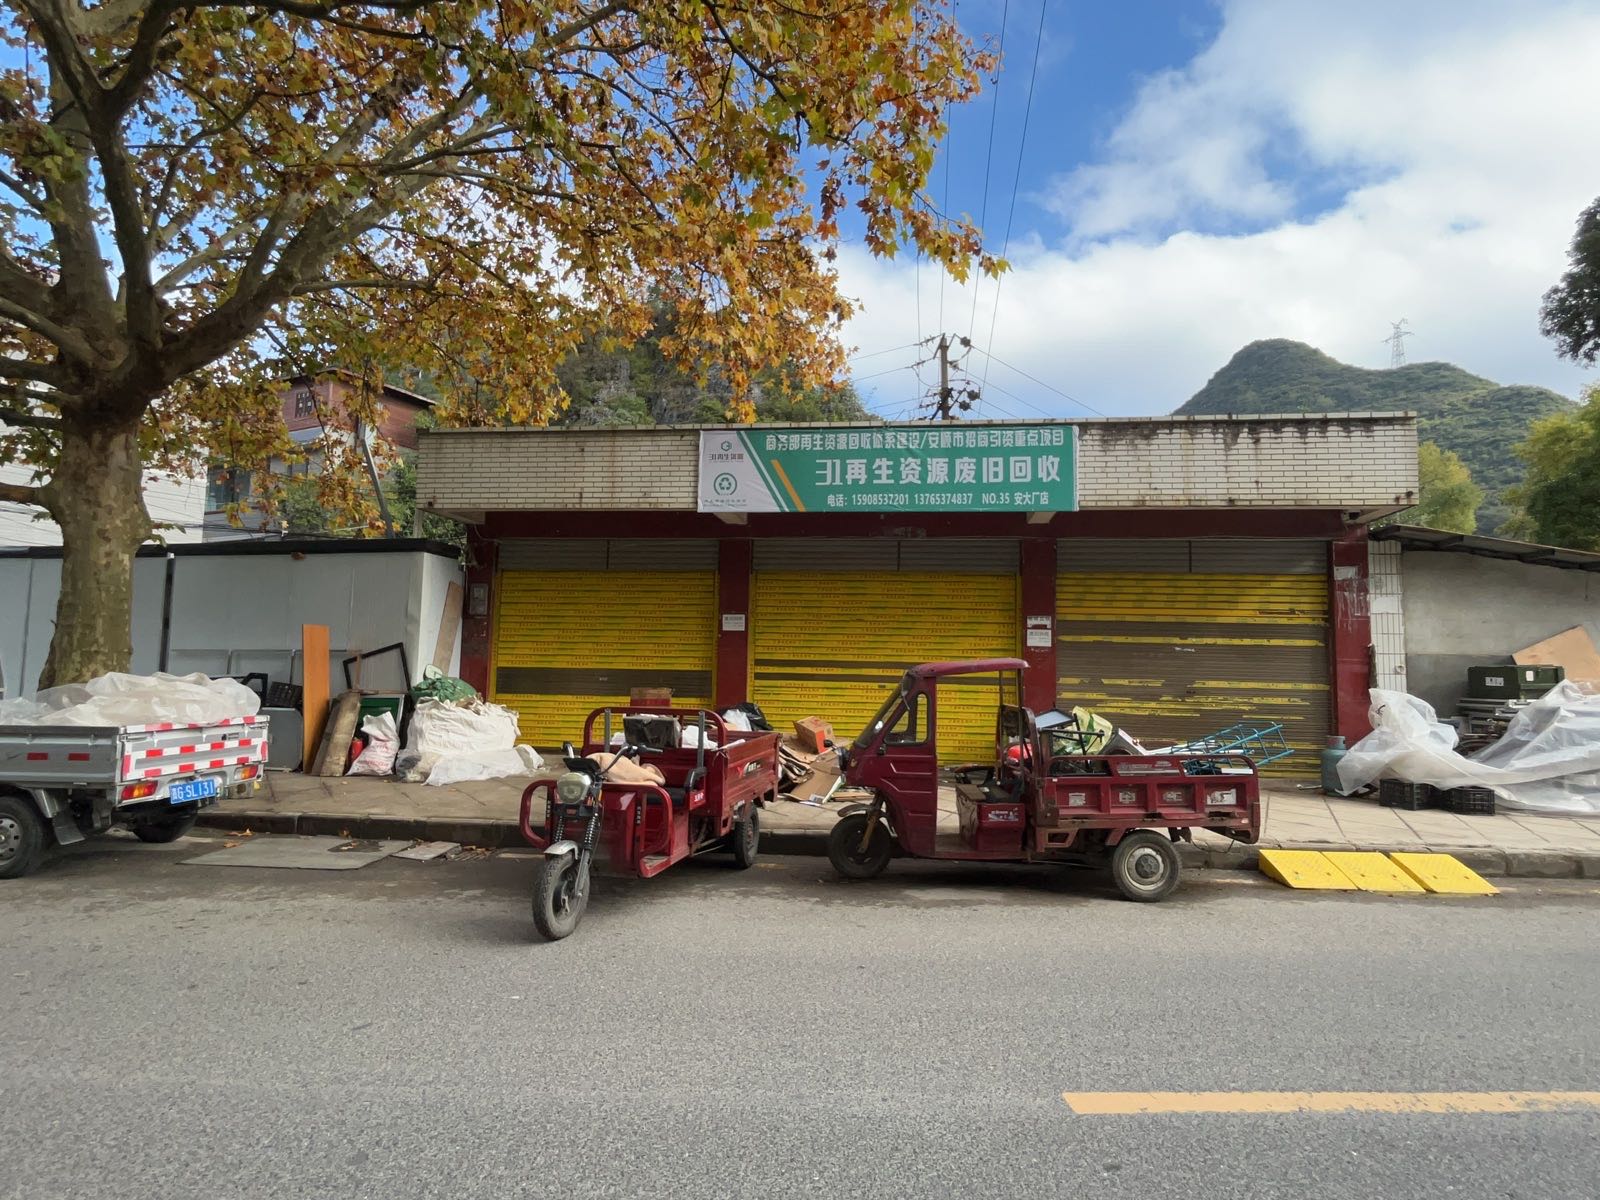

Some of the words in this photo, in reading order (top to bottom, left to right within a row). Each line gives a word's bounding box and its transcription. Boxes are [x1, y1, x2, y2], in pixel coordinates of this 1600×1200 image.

[815, 456, 1061, 486] 31再生资源废旧回收
[852, 493, 909, 506] 15908537201
[914, 493, 973, 505] 13765374837
[982, 493, 1010, 504] NO.35
[1014, 491, 1049, 505] 安大厂店
